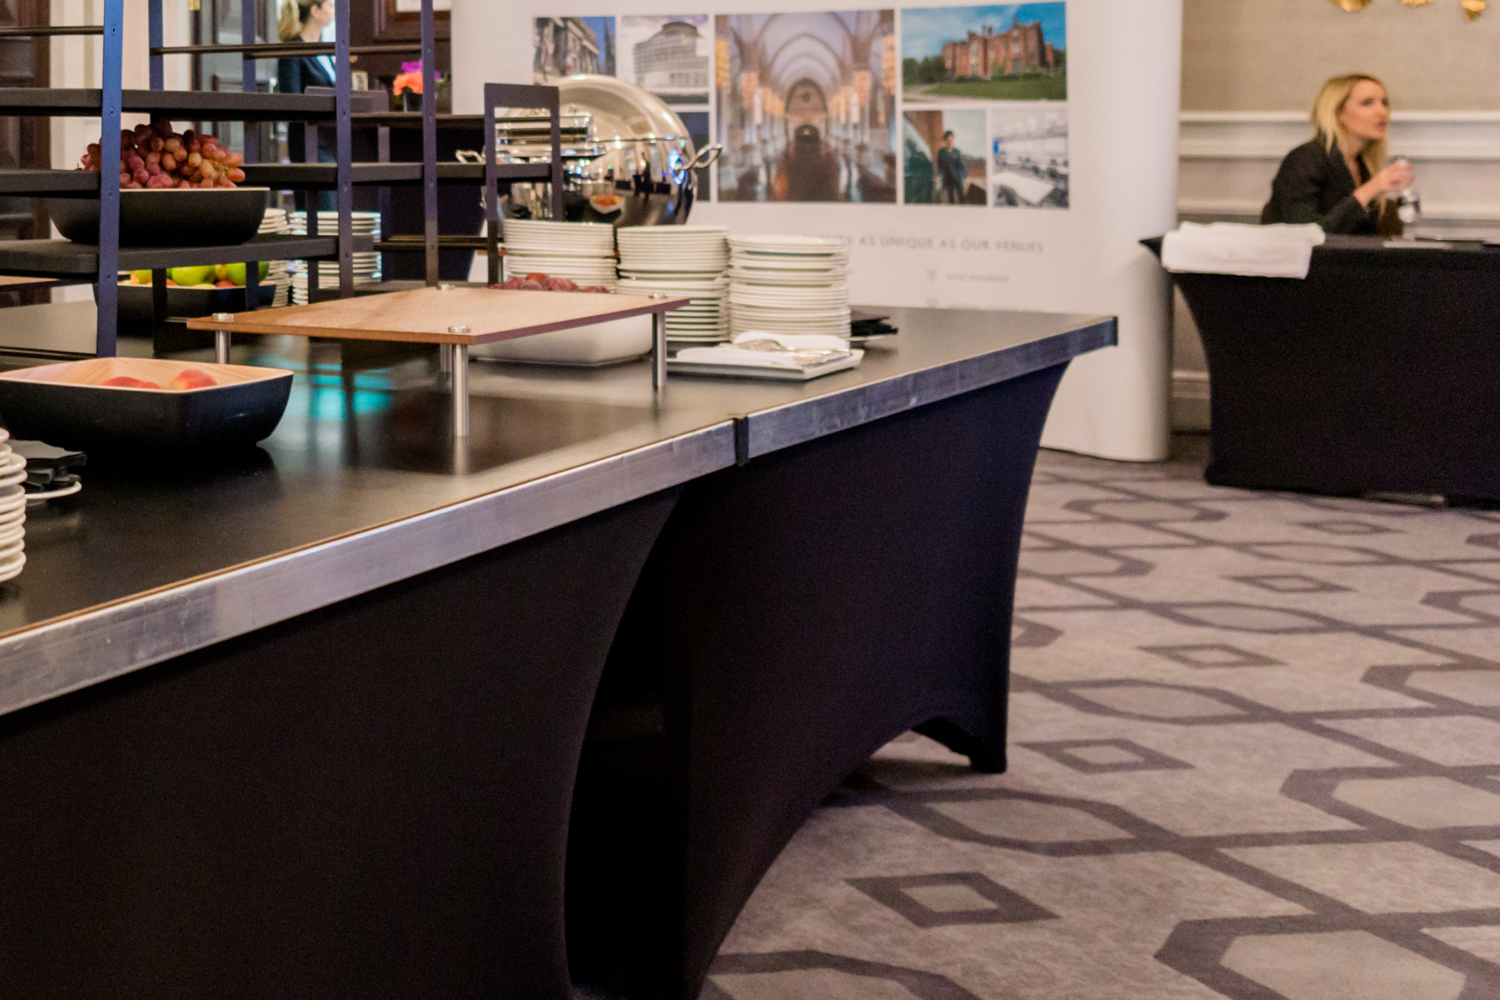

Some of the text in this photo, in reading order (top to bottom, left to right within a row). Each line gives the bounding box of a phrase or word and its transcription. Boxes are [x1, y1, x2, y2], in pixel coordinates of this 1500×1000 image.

[859, 236, 876, 248] AS
[880, 236, 934, 250] UNIQUE
[939, 238, 956, 250] AS
[960, 239, 990, 252] OUR
[994, 240, 1045, 255] VENUES
